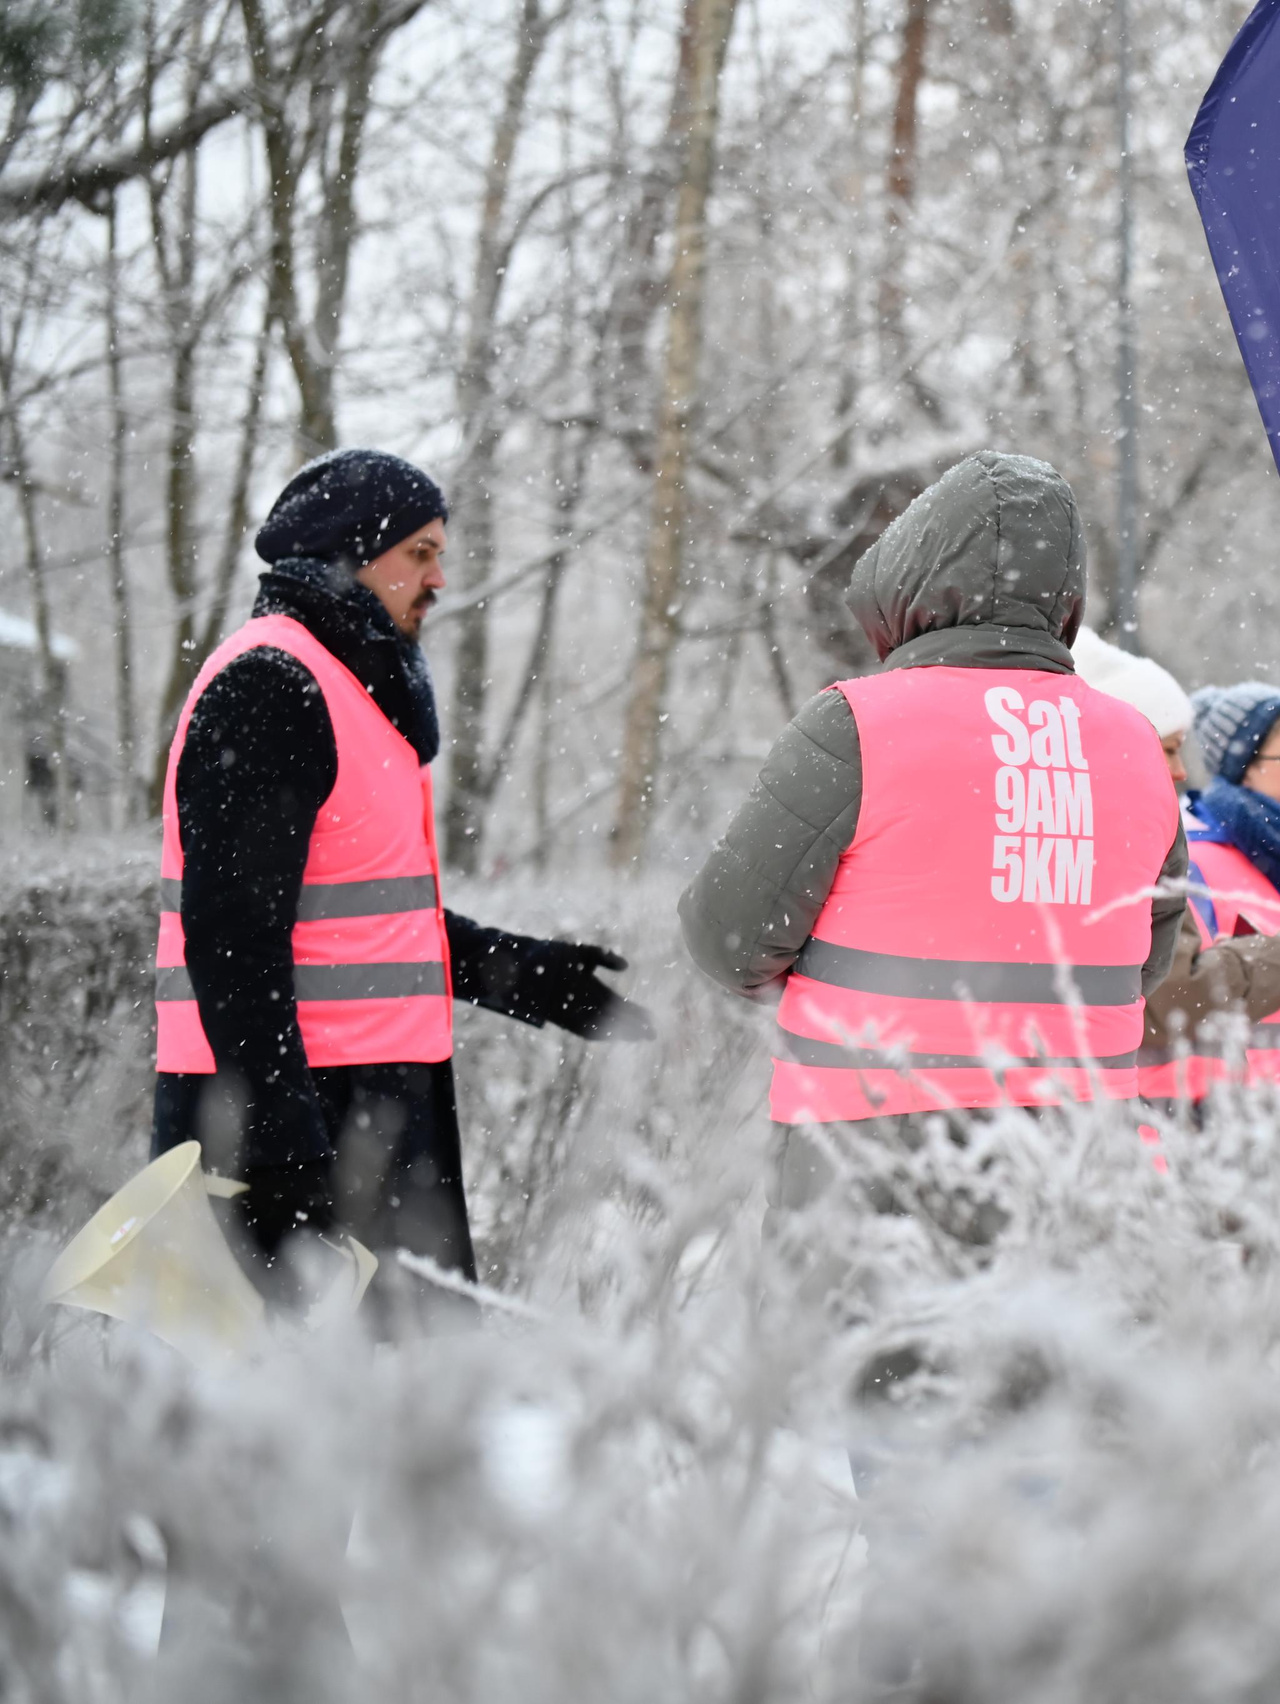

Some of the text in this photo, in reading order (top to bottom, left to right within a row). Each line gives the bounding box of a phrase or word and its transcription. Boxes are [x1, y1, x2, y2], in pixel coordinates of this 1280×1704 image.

[984, 686, 1089, 770] Sat
[995, 765, 1094, 837] 9AM
[990, 835, 1094, 905] 5KM
